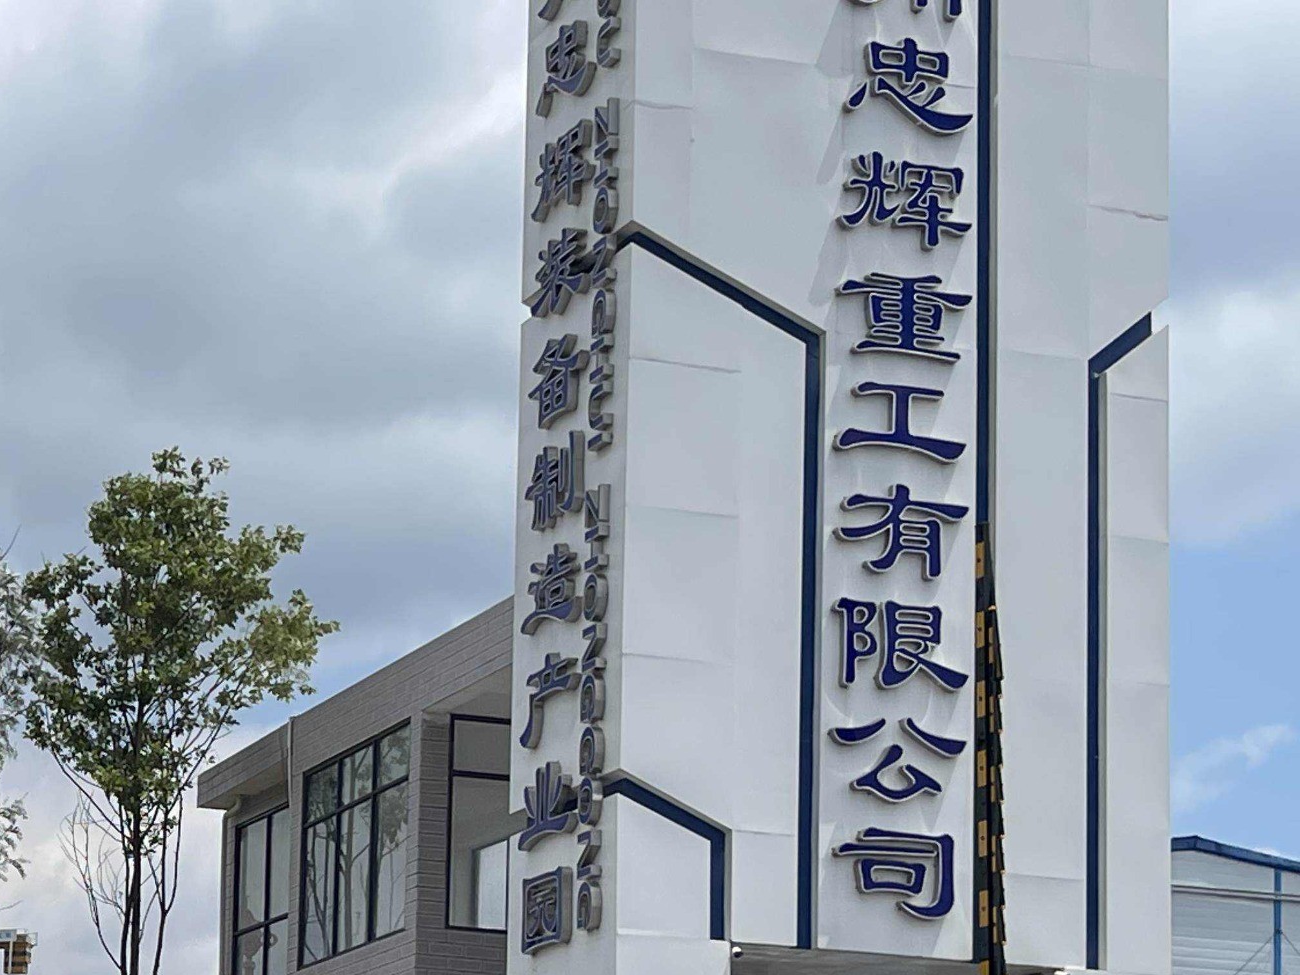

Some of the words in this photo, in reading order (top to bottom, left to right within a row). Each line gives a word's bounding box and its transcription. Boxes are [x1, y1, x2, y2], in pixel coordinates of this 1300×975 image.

[518, 0, 597, 954] 忠辉装备制造产业园
[587, 97, 621, 452] ZHONGHUI
[828, 0, 975, 919] 忠辉重工有限公司
[576, 483, 612, 932] ZHONGGONG
